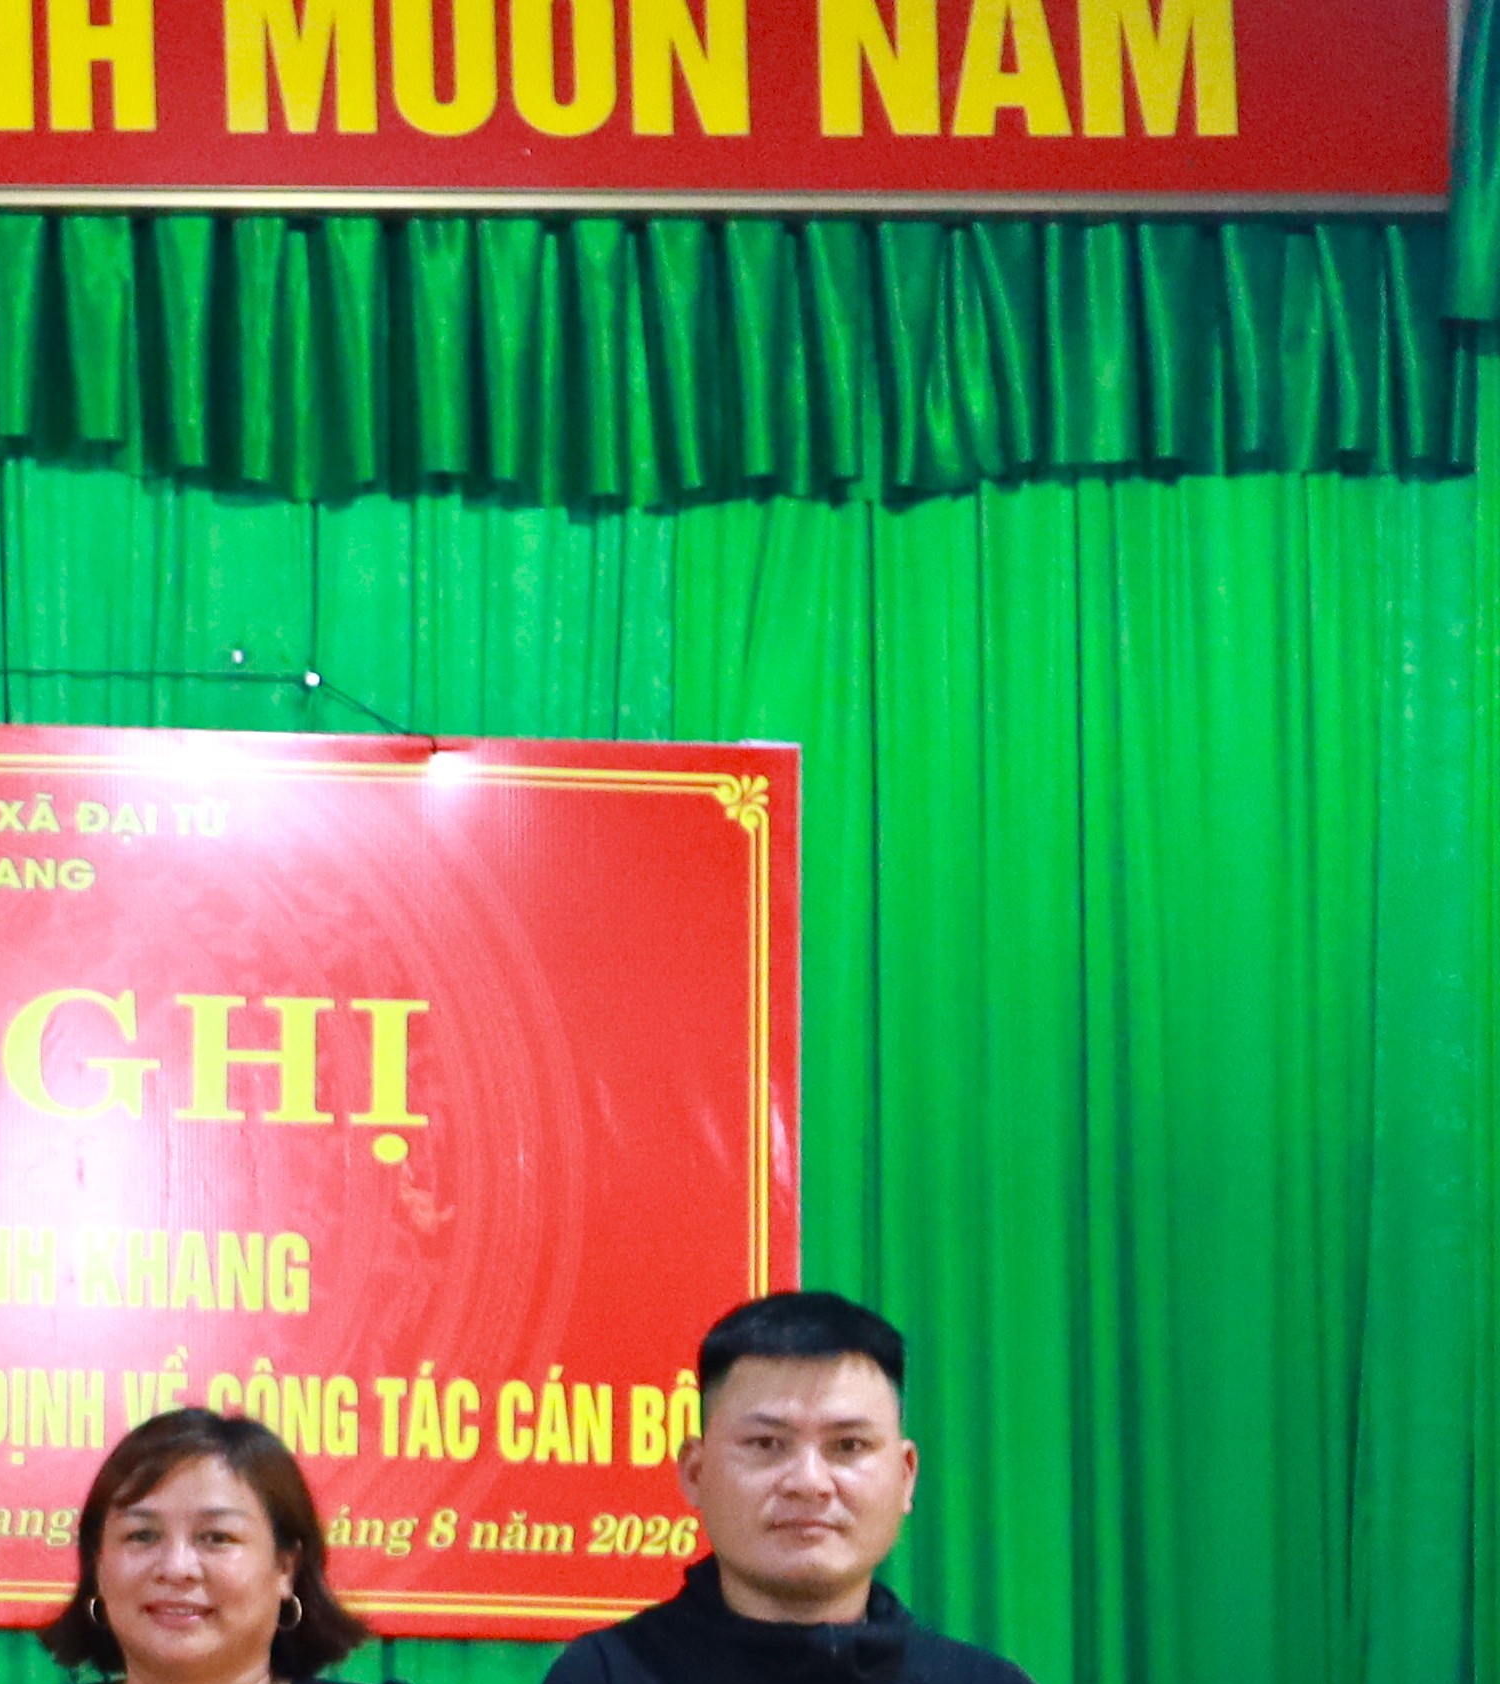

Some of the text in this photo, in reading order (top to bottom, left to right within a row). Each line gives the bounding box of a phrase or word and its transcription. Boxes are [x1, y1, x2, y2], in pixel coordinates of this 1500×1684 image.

[76, 800, 157, 844] ĐẠI
[80, 1226, 312, 1313] KHANG
[375, 1360, 481, 1461] TÁC
[498, 1364, 613, 1465] CÁN
[325, 1504, 419, 1556] áng
[427, 1507, 460, 1549] 8
[469, 1511, 576, 1554] năm
[587, 1513, 700, 1557] 2026
